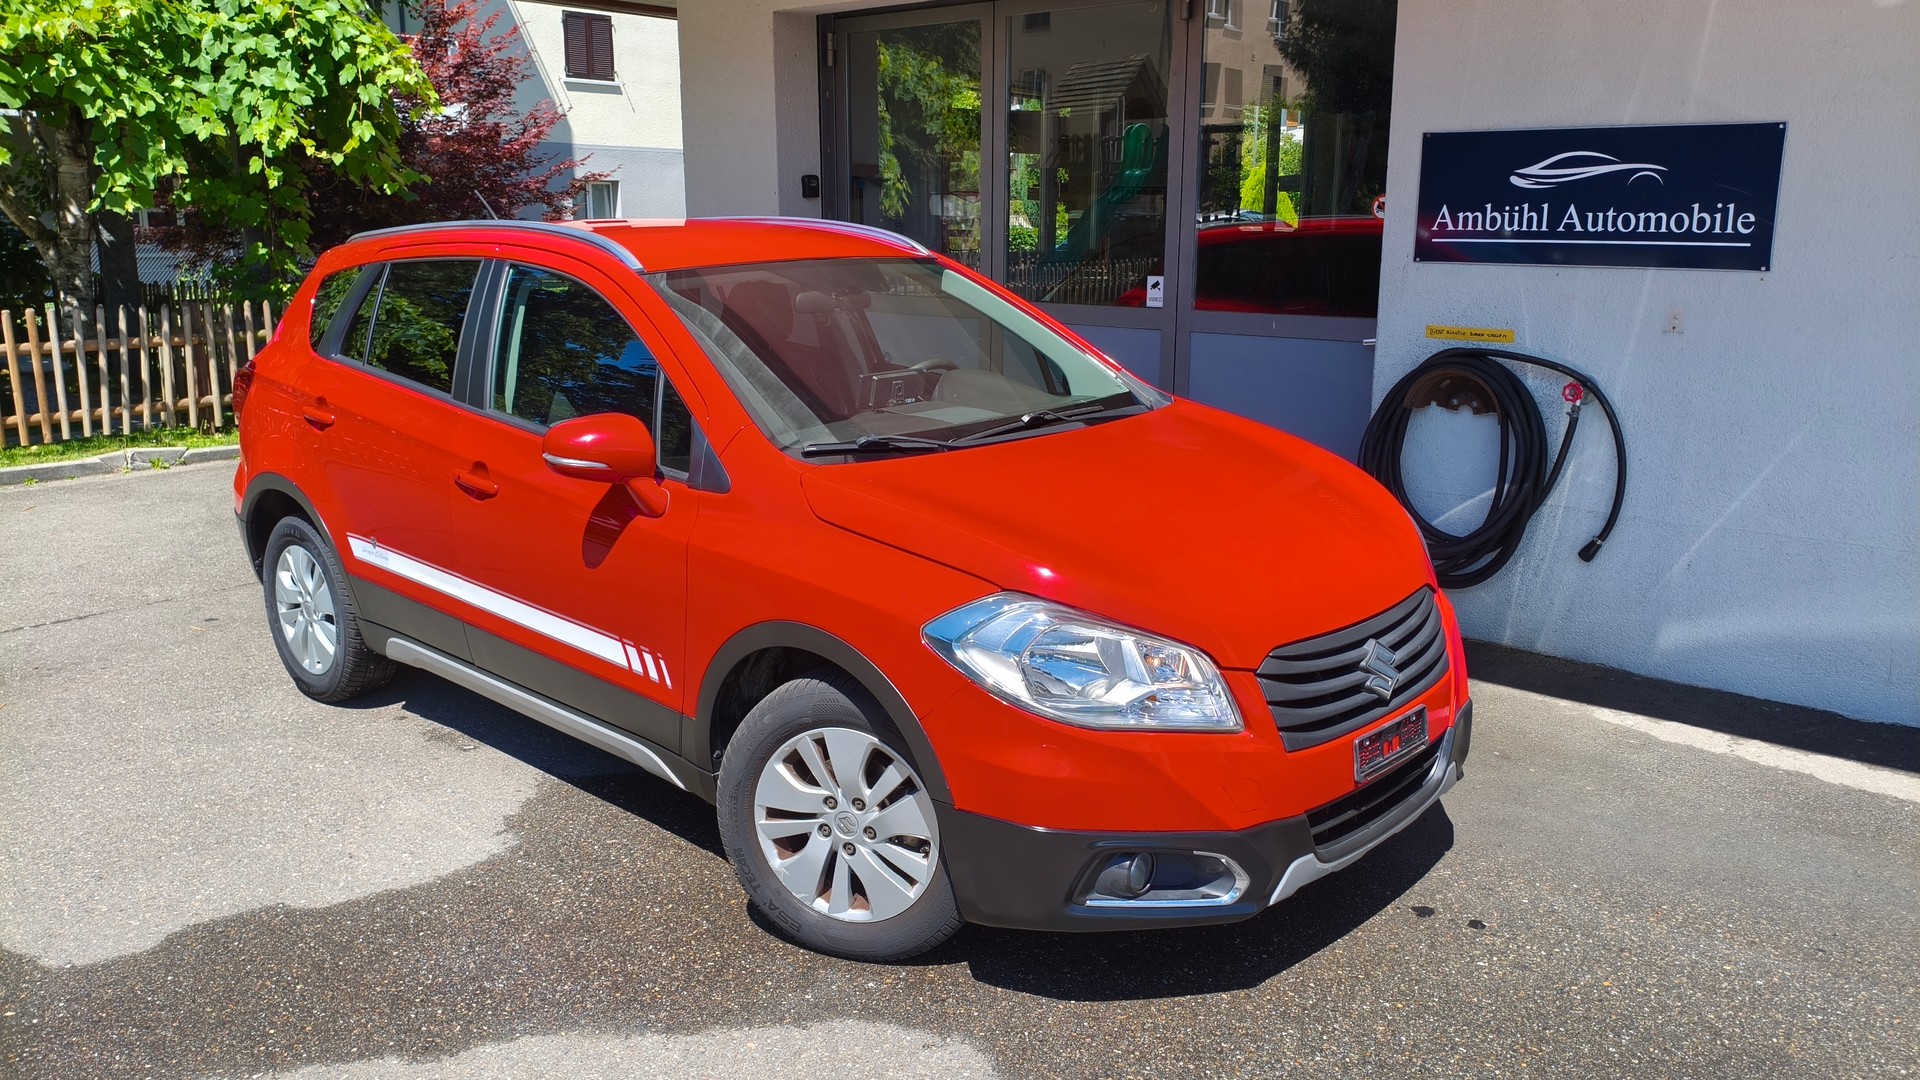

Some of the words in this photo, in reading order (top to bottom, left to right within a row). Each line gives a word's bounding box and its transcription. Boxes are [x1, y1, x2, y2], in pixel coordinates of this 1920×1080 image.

[1430, 202, 1549, 233] Ambühl
[1556, 202, 1756, 235] Automobile
[733, 847, 762, 894] TECAR
